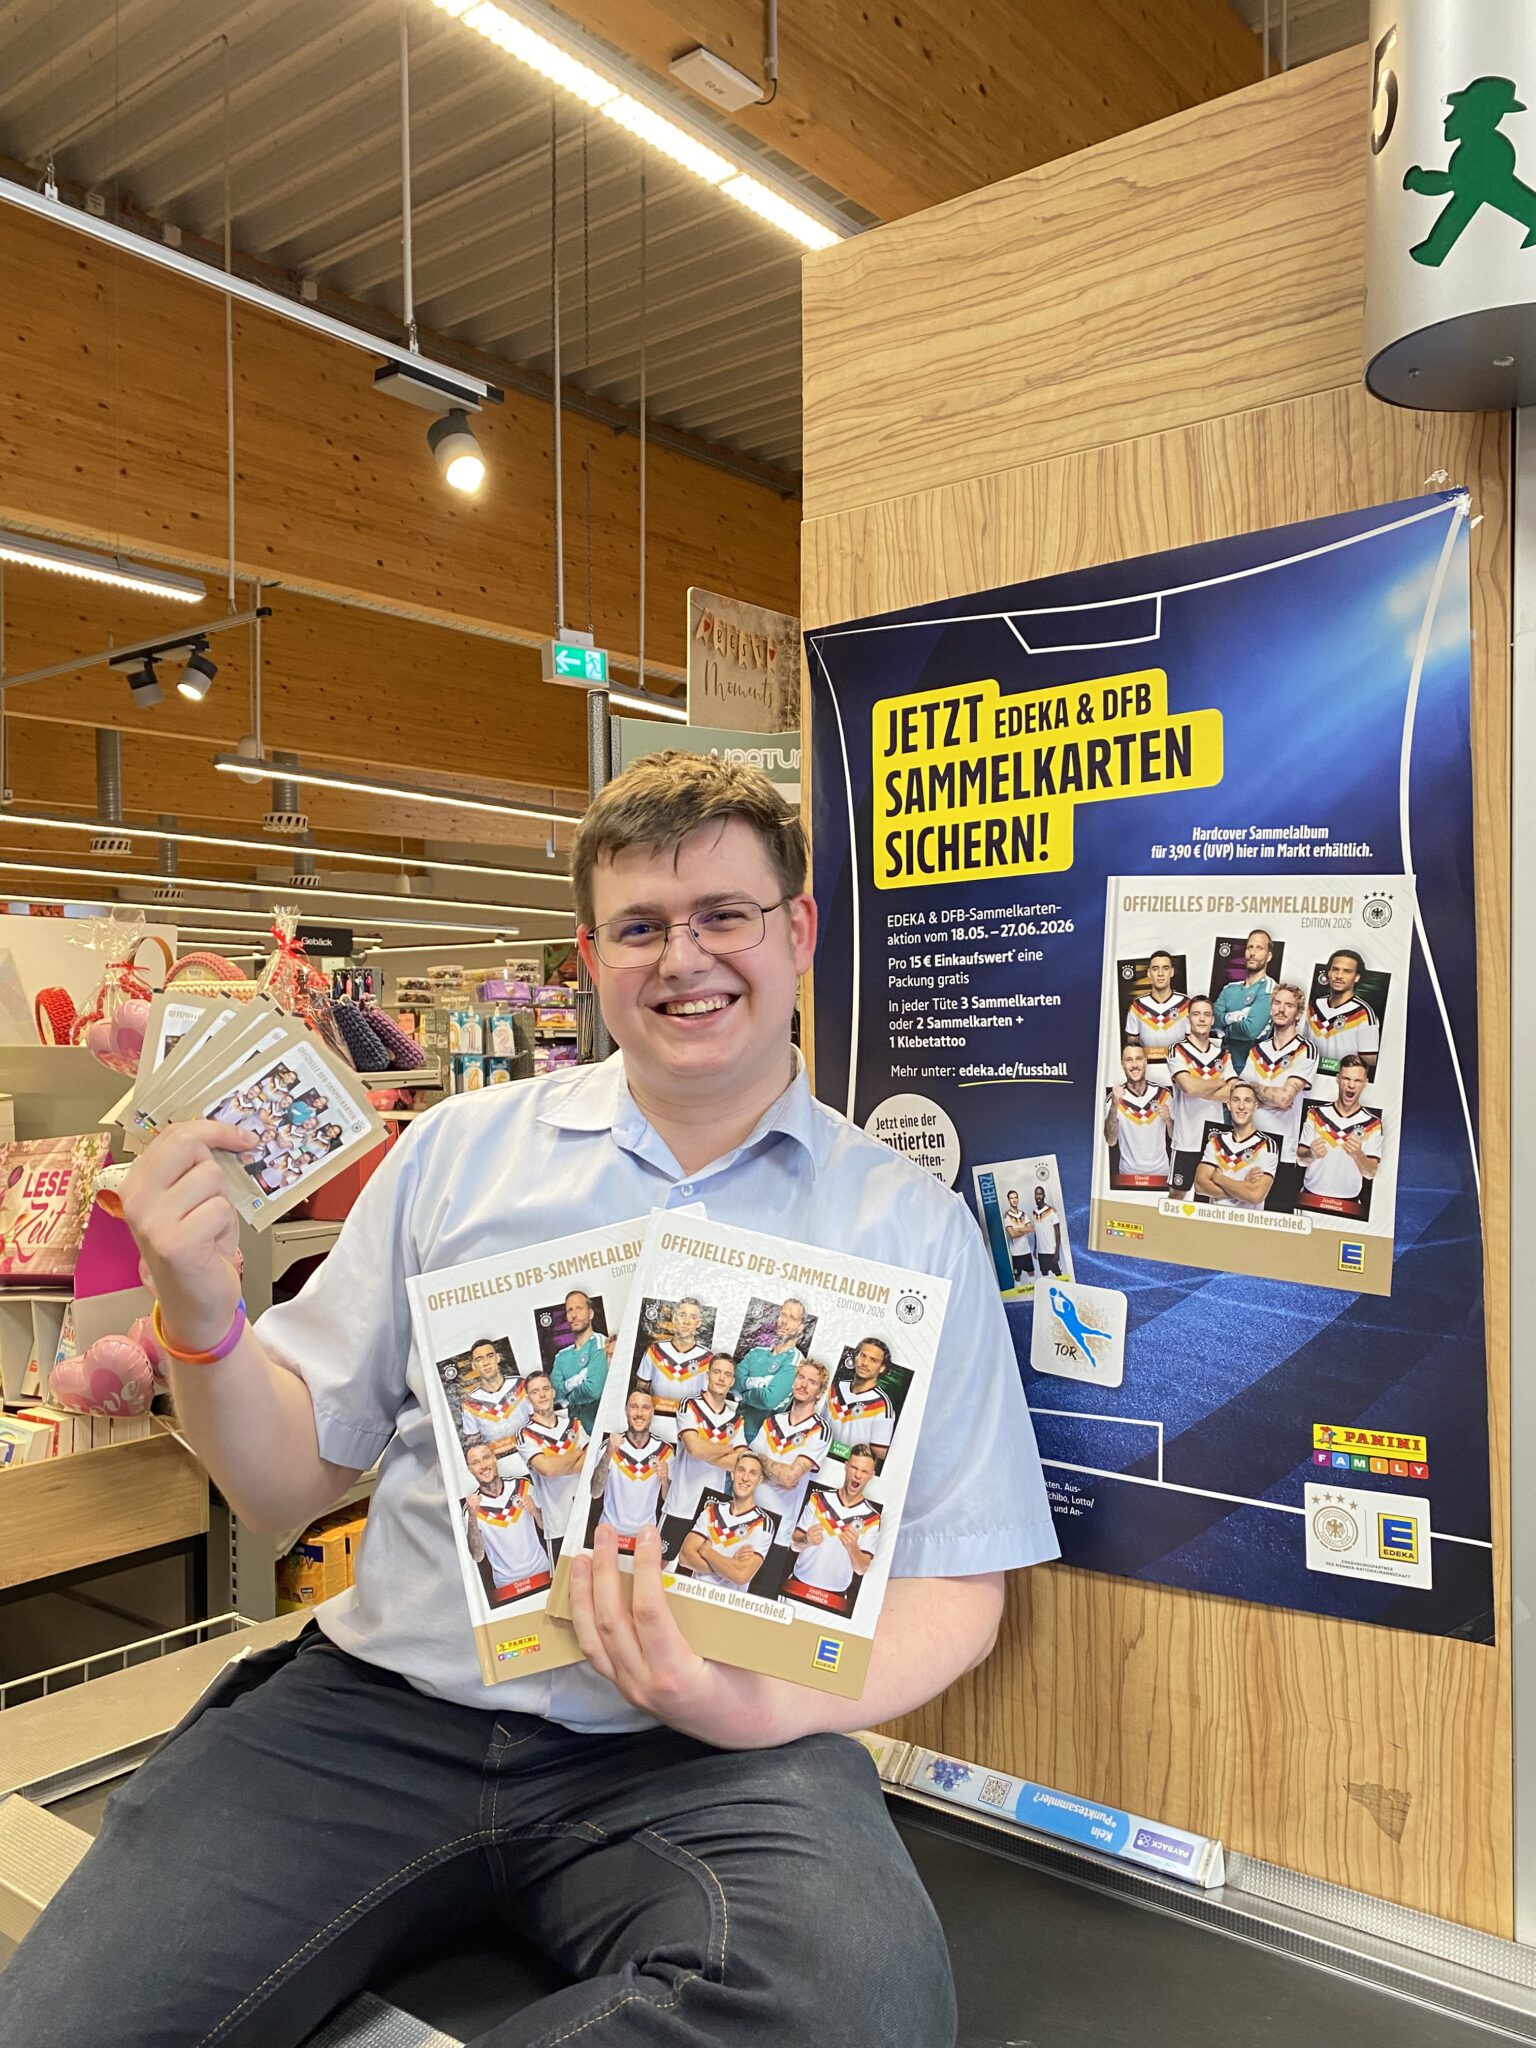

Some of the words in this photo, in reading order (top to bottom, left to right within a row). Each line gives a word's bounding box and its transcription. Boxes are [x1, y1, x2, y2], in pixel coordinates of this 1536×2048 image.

[715, 627, 764, 660] BEST
[704, 658, 774, 709] Moments
[884, 694, 985, 757] JETZT
[995, 697, 1069, 739] EDEKA
[1076, 693, 1094, 725] &
[1102, 683, 1151, 721] DFB
[885, 724, 1192, 818] SAMMELKARTEN
[1192, 826, 1248, 841] Hardcover
[1249, 824, 1329, 841] Sammelalbum
[885, 811, 1050, 878] SICHERN!
[1151, 844, 1167, 859] für
[1168, 844, 1192, 860] 3,90
[1193, 845, 1201, 858] €
[1203, 843, 1234, 861] (UVP)
[1236, 844, 1259, 858] hier
[1260, 844, 1274, 858] im
[1276, 843, 1310, 858] Markt
[1312, 843, 1374, 858] erhältlich.
[1122, 894, 1204, 914] OFFIZIELLES
[1206, 895, 1354, 915] DFB-SAMMELALBUM
[887, 912, 926, 927] EDEKA
[928, 911, 938, 925] &
[941, 904, 1062, 923] DFB-Sammelkarten-
[1300, 917, 1331, 929] EDITION
[1332, 917, 1352, 929] 2026
[301, 936, 333, 947] Gebäck
[887, 932, 921, 946] aktion
[924, 931, 948, 943] vom
[950, 926, 989, 941] 18.05.
[1000, 919, 1075, 938] 27.06.2026
[888, 956, 907, 970] Pro
[1017, 949, 1043, 962] eine
[888, 974, 934, 989] Packung
[937, 971, 970, 988] gratis
[888, 1000, 899, 1012] In
[901, 998, 930, 1015] jeder
[932, 997, 958, 1010] Tüte
[960, 997, 969, 1010] 3
[971, 993, 1062, 1009] Sammelkarten
[889, 1017, 914, 1030] oder
[916, 1017, 924, 1030] 2
[926, 1014, 1012, 1030] Sammelkarten
[1015, 1015, 1025, 1024] +
[889, 1036, 895, 1048] 1
[897, 1034, 966, 1048] Klebetattoo
[890, 1065, 918, 1078] Mehr
[921, 1066, 956, 1078] unter:
[958, 1062, 1068, 1079] edeka.de/fussball
[876, 1117, 899, 1131] Jetzt
[900, 1114, 919, 1128] eine
[921, 1112, 937, 1126] der
[872, 1131, 946, 1151] mitierten
[23, 1169, 73, 1199] LESE
[981, 1173, 998, 1205] HERZ
[1164, 1202, 1180, 1214] Das
[1198, 1208, 1226, 1221] macht
[1228, 1209, 1245, 1223] den
[1247, 1212, 1307, 1232] Unterschied.
[12, 1200, 67, 1263] Zeit
[427, 1274, 513, 1312] OFFIZIELLES
[516, 1239, 645, 1289] DFB-SAMMELALBU
[660, 1231, 746, 1268] OFFIZIELLES
[746, 1253, 892, 1306] DFB-SAMMELALBUM
[836, 1297, 866, 1314] EDITION
[866, 1304, 886, 1319] 2026
[1054, 1342, 1078, 1361] TOR
[1344, 1431, 1421, 1451] PANINI
[1318, 1454, 1424, 1476] FAMILY
[1064, 1483, 1081, 1492] Aus-
[1053, 1505, 1068, 1514] und
[1070, 1506, 1084, 1516] An-
[1071, 1495, 1095, 1508] Lotto/
[1383, 1549, 1415, 1560] EDEKA
[677, 1581, 707, 1597] macht
[708, 1588, 726, 1604] den
[728, 1593, 787, 1620] Unterschied.
[508, 1636, 537, 1648] PANINI
[815, 1659, 837, 1670] EDEKA
[1091, 1826, 1113, 1843] Kein
[1151, 1839, 1189, 1859] PAYBACK
